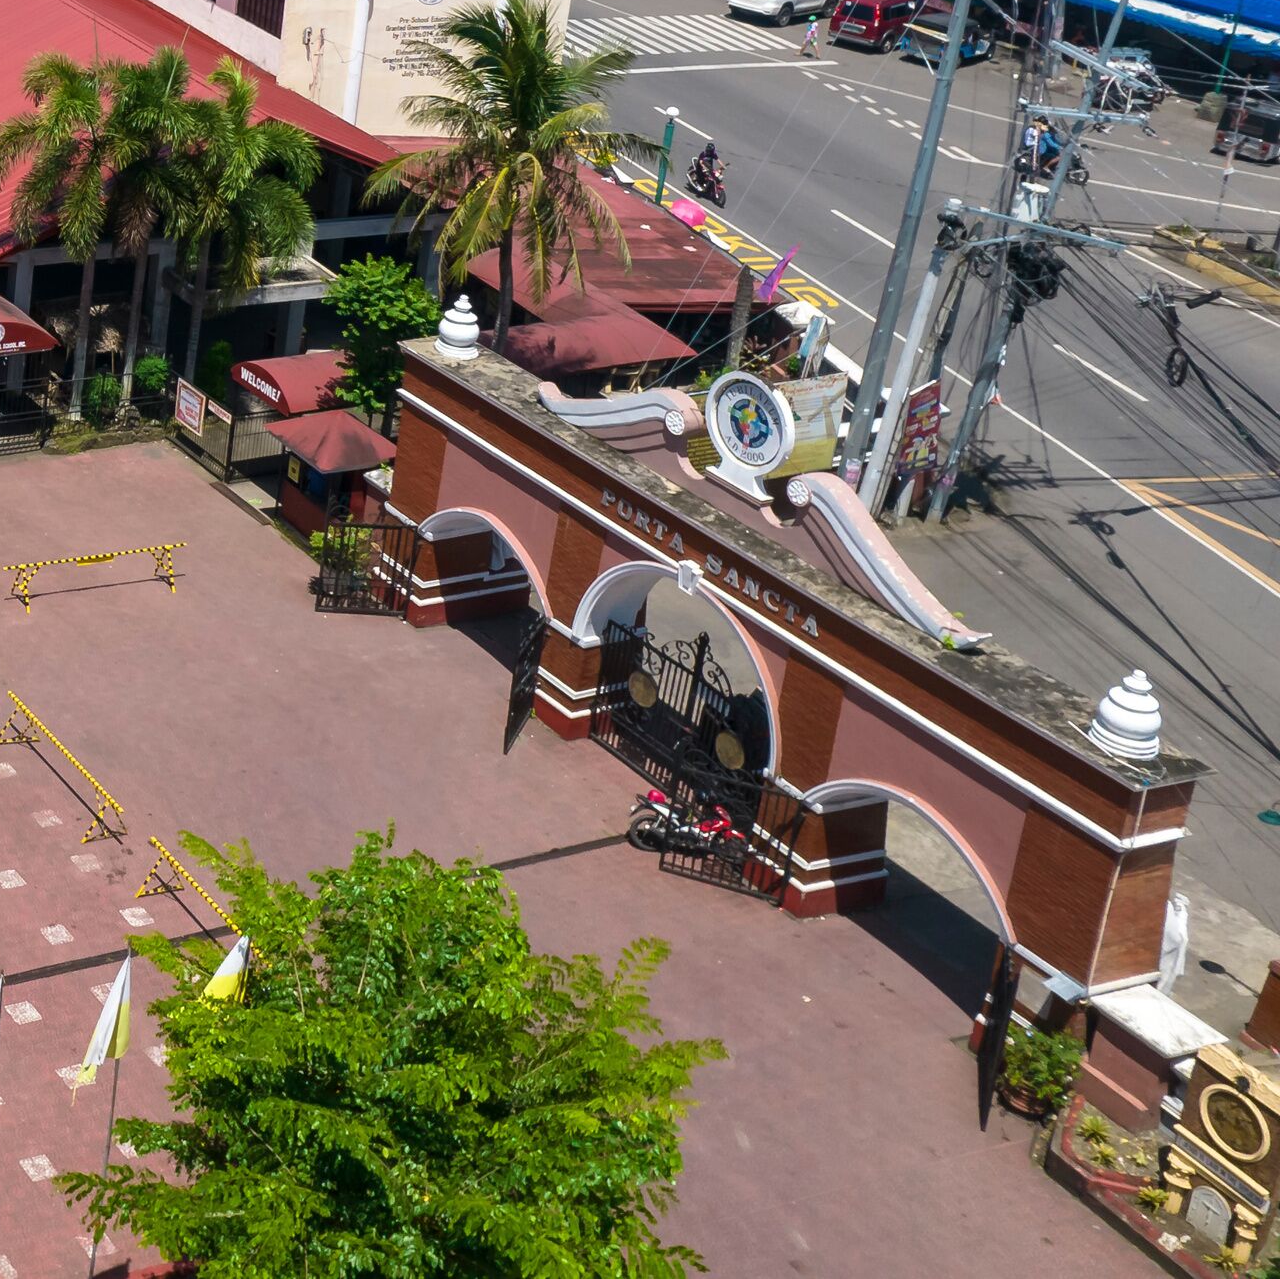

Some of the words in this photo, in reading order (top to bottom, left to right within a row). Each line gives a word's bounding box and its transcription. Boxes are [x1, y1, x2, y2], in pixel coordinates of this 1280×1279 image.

[240, 366, 281, 403] WELCOME!
[740, 450, 765, 462] 2000
[600, 487, 686, 554] PORTA
[704, 552, 821, 638] SANCTA
